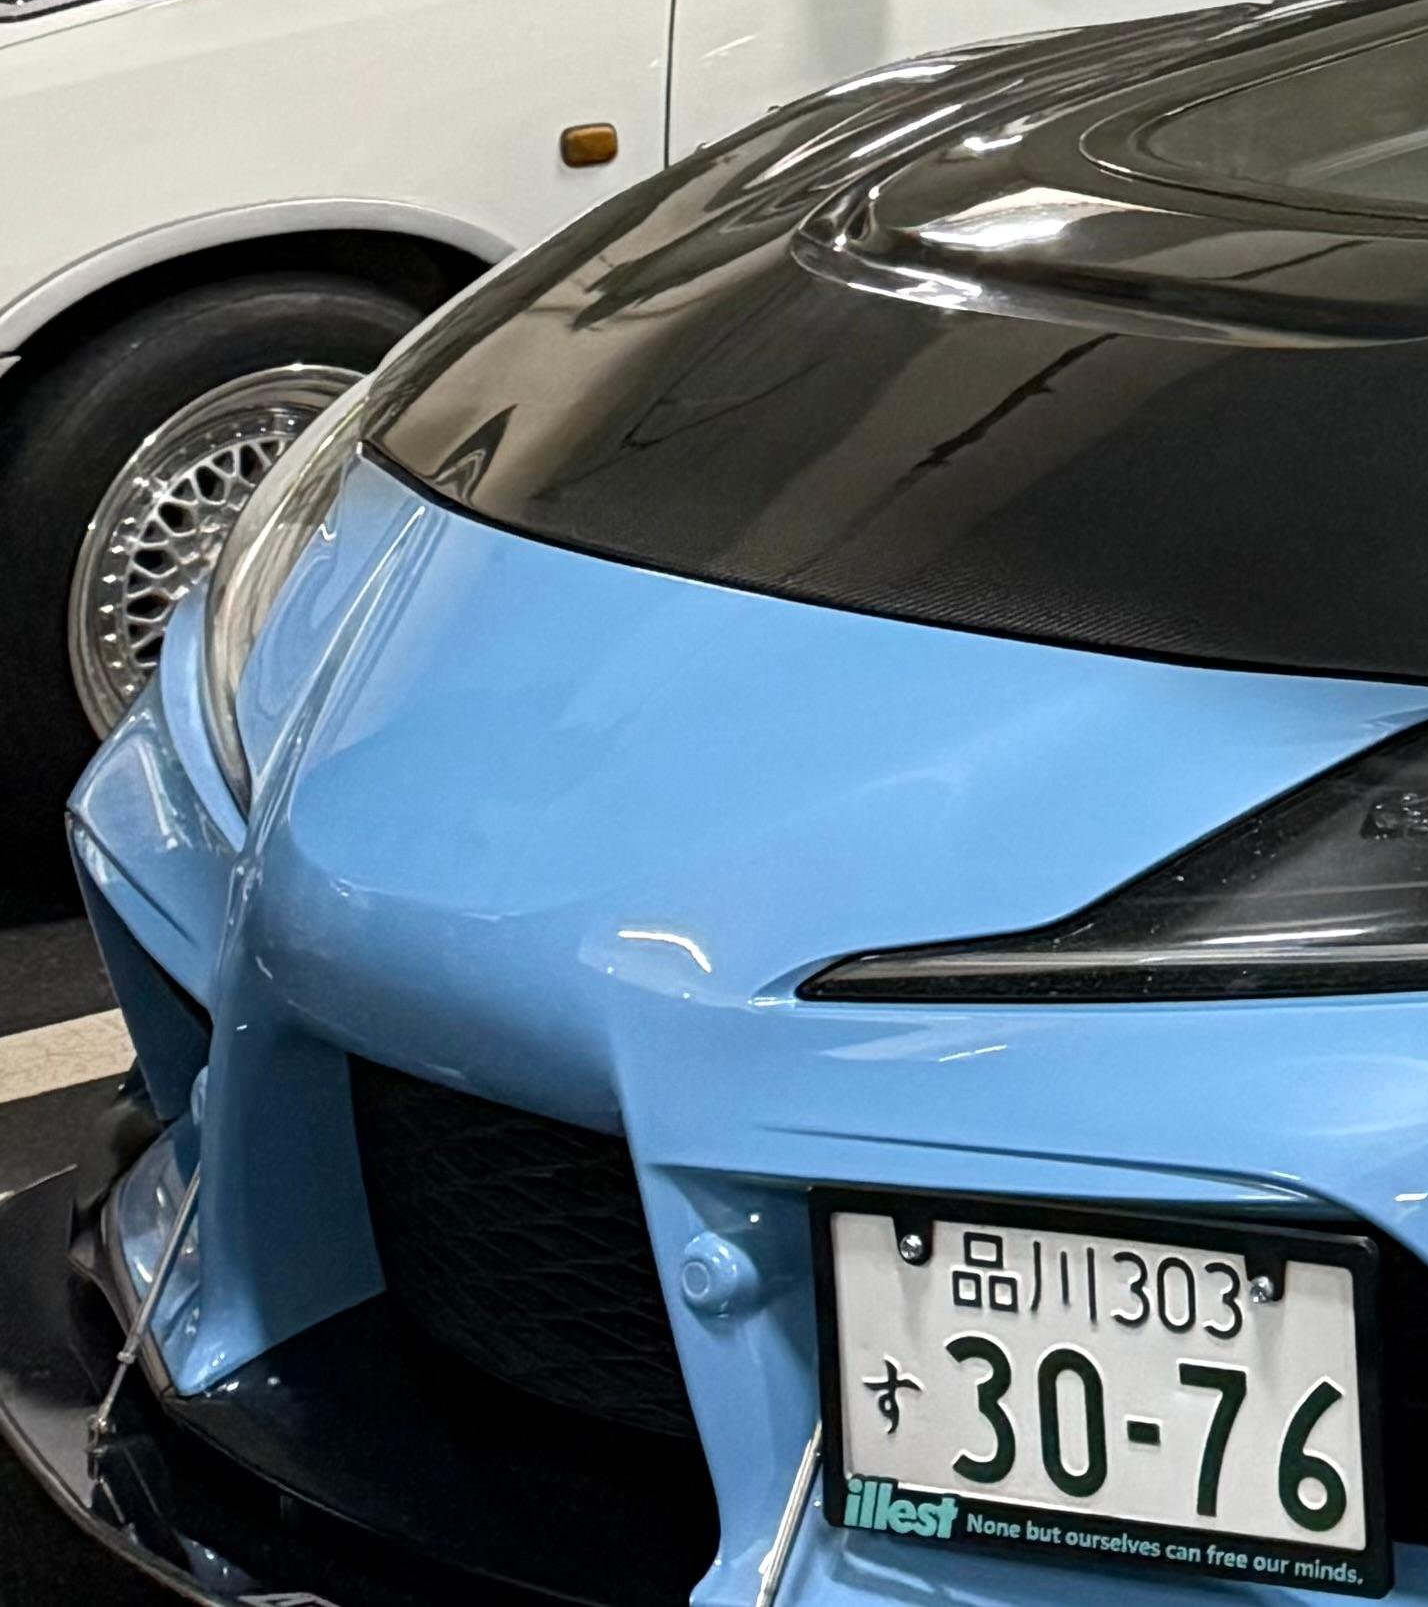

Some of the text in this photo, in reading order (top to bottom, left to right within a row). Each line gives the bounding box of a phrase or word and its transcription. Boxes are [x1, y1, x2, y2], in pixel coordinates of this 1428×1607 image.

[862, 1335, 1347, 1532] す 30-76
[843, 1478, 959, 1539] illest
[966, 1513, 1364, 1585] None but ourselves can free our minds.
